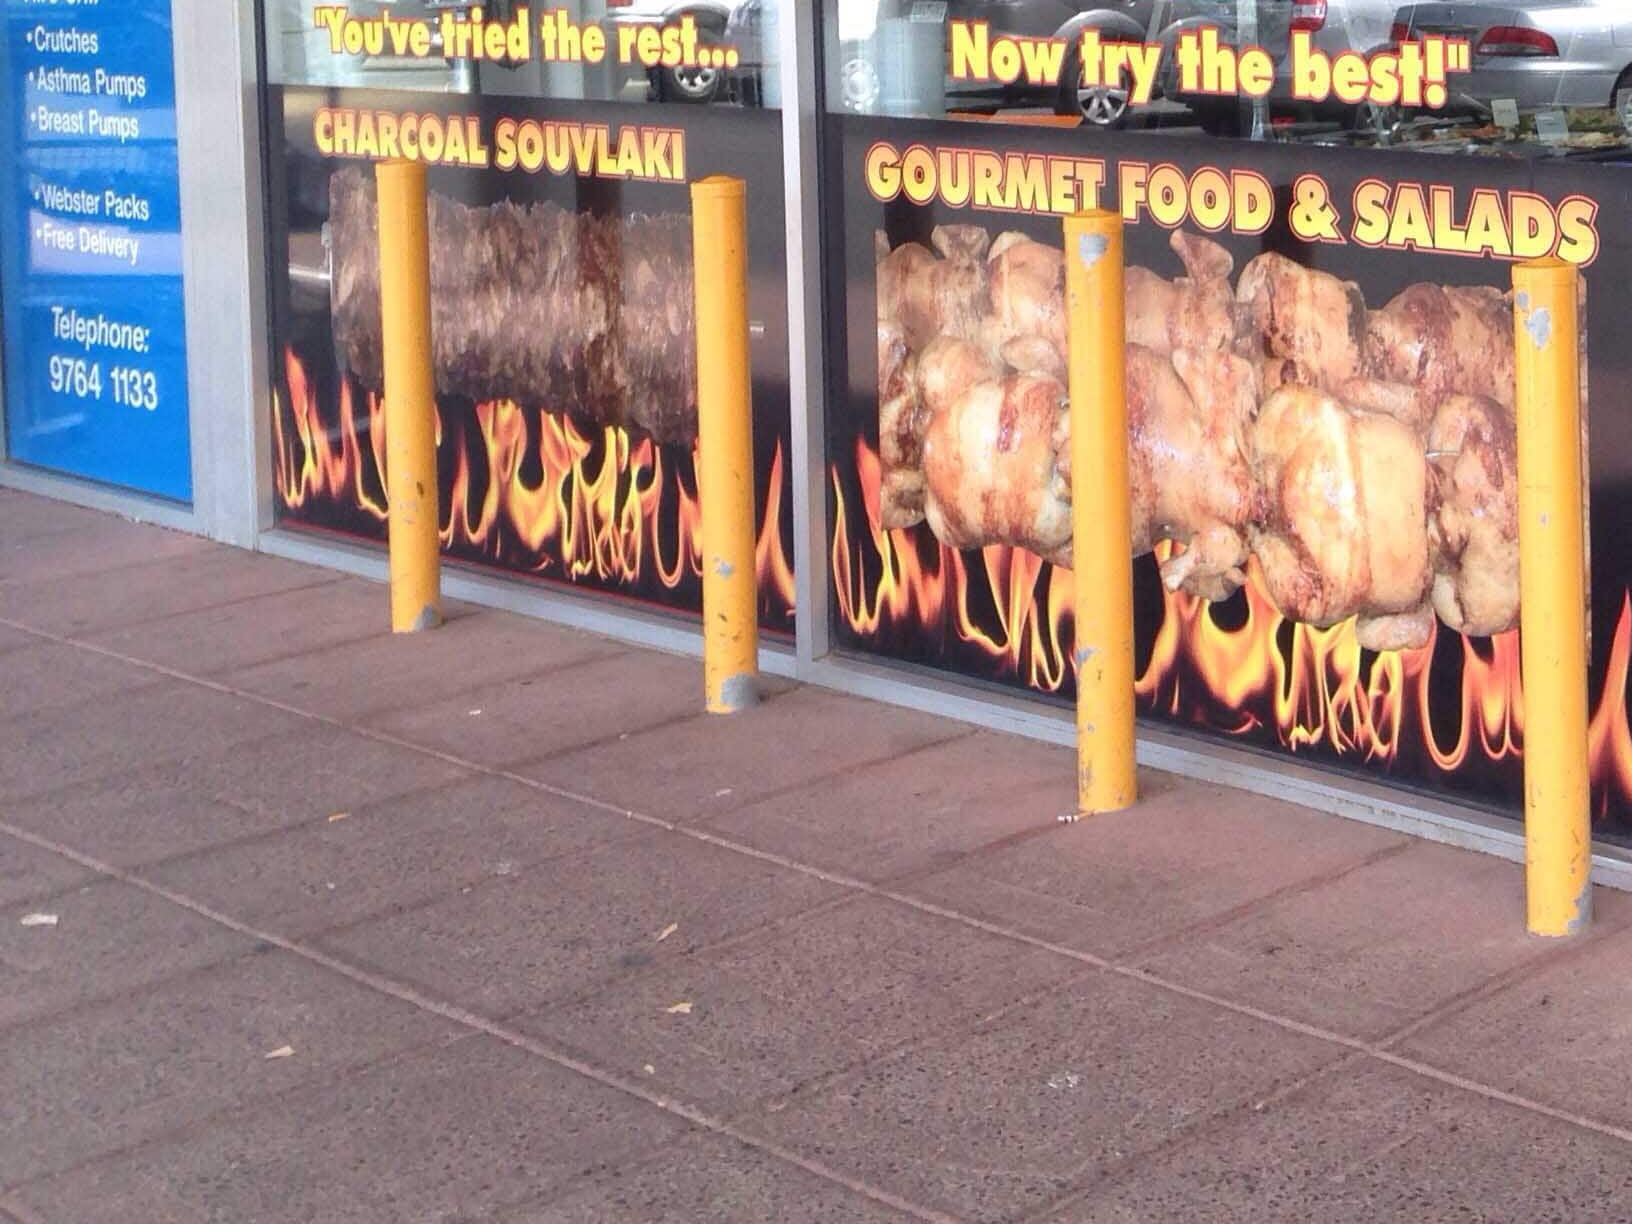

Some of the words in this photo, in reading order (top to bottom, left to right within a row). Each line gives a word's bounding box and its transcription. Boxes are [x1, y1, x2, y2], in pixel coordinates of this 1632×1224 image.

[34, 27, 99, 54] Crutches
[313, 5, 431, 58] "You've
[441, 4, 530, 61] tried
[541, 6, 606, 65] the
[618, 15, 739, 69] rest...
[37, 68, 91, 96] Asthma
[95, 68, 146, 104] Pumps
[949, 19, 1067, 85] Now
[1078, 25, 1163, 108] try
[1175, 25, 1275, 99] the
[1290, 28, 1473, 109] best!"
[38, 107, 85, 135] Breast
[89, 110, 139, 143] Pumps
[312, 107, 488, 168] CHARCOAL
[494, 119, 687, 184] SOUVLAKI
[42, 183, 101, 215] Webster
[104, 191, 150, 222] Packs
[864, 141, 1108, 216] GOURMET
[1119, 159, 1275, 236] FOOD
[1288, 172, 1347, 245] &
[1352, 175, 1603, 267] SALADS
[42, 227, 75, 251] Free
[79, 231, 139, 265] Delivery
[51, 305, 151, 353] Telephone:
[49, 354, 101, 400] 9764
[110, 364, 159, 412] 1133
